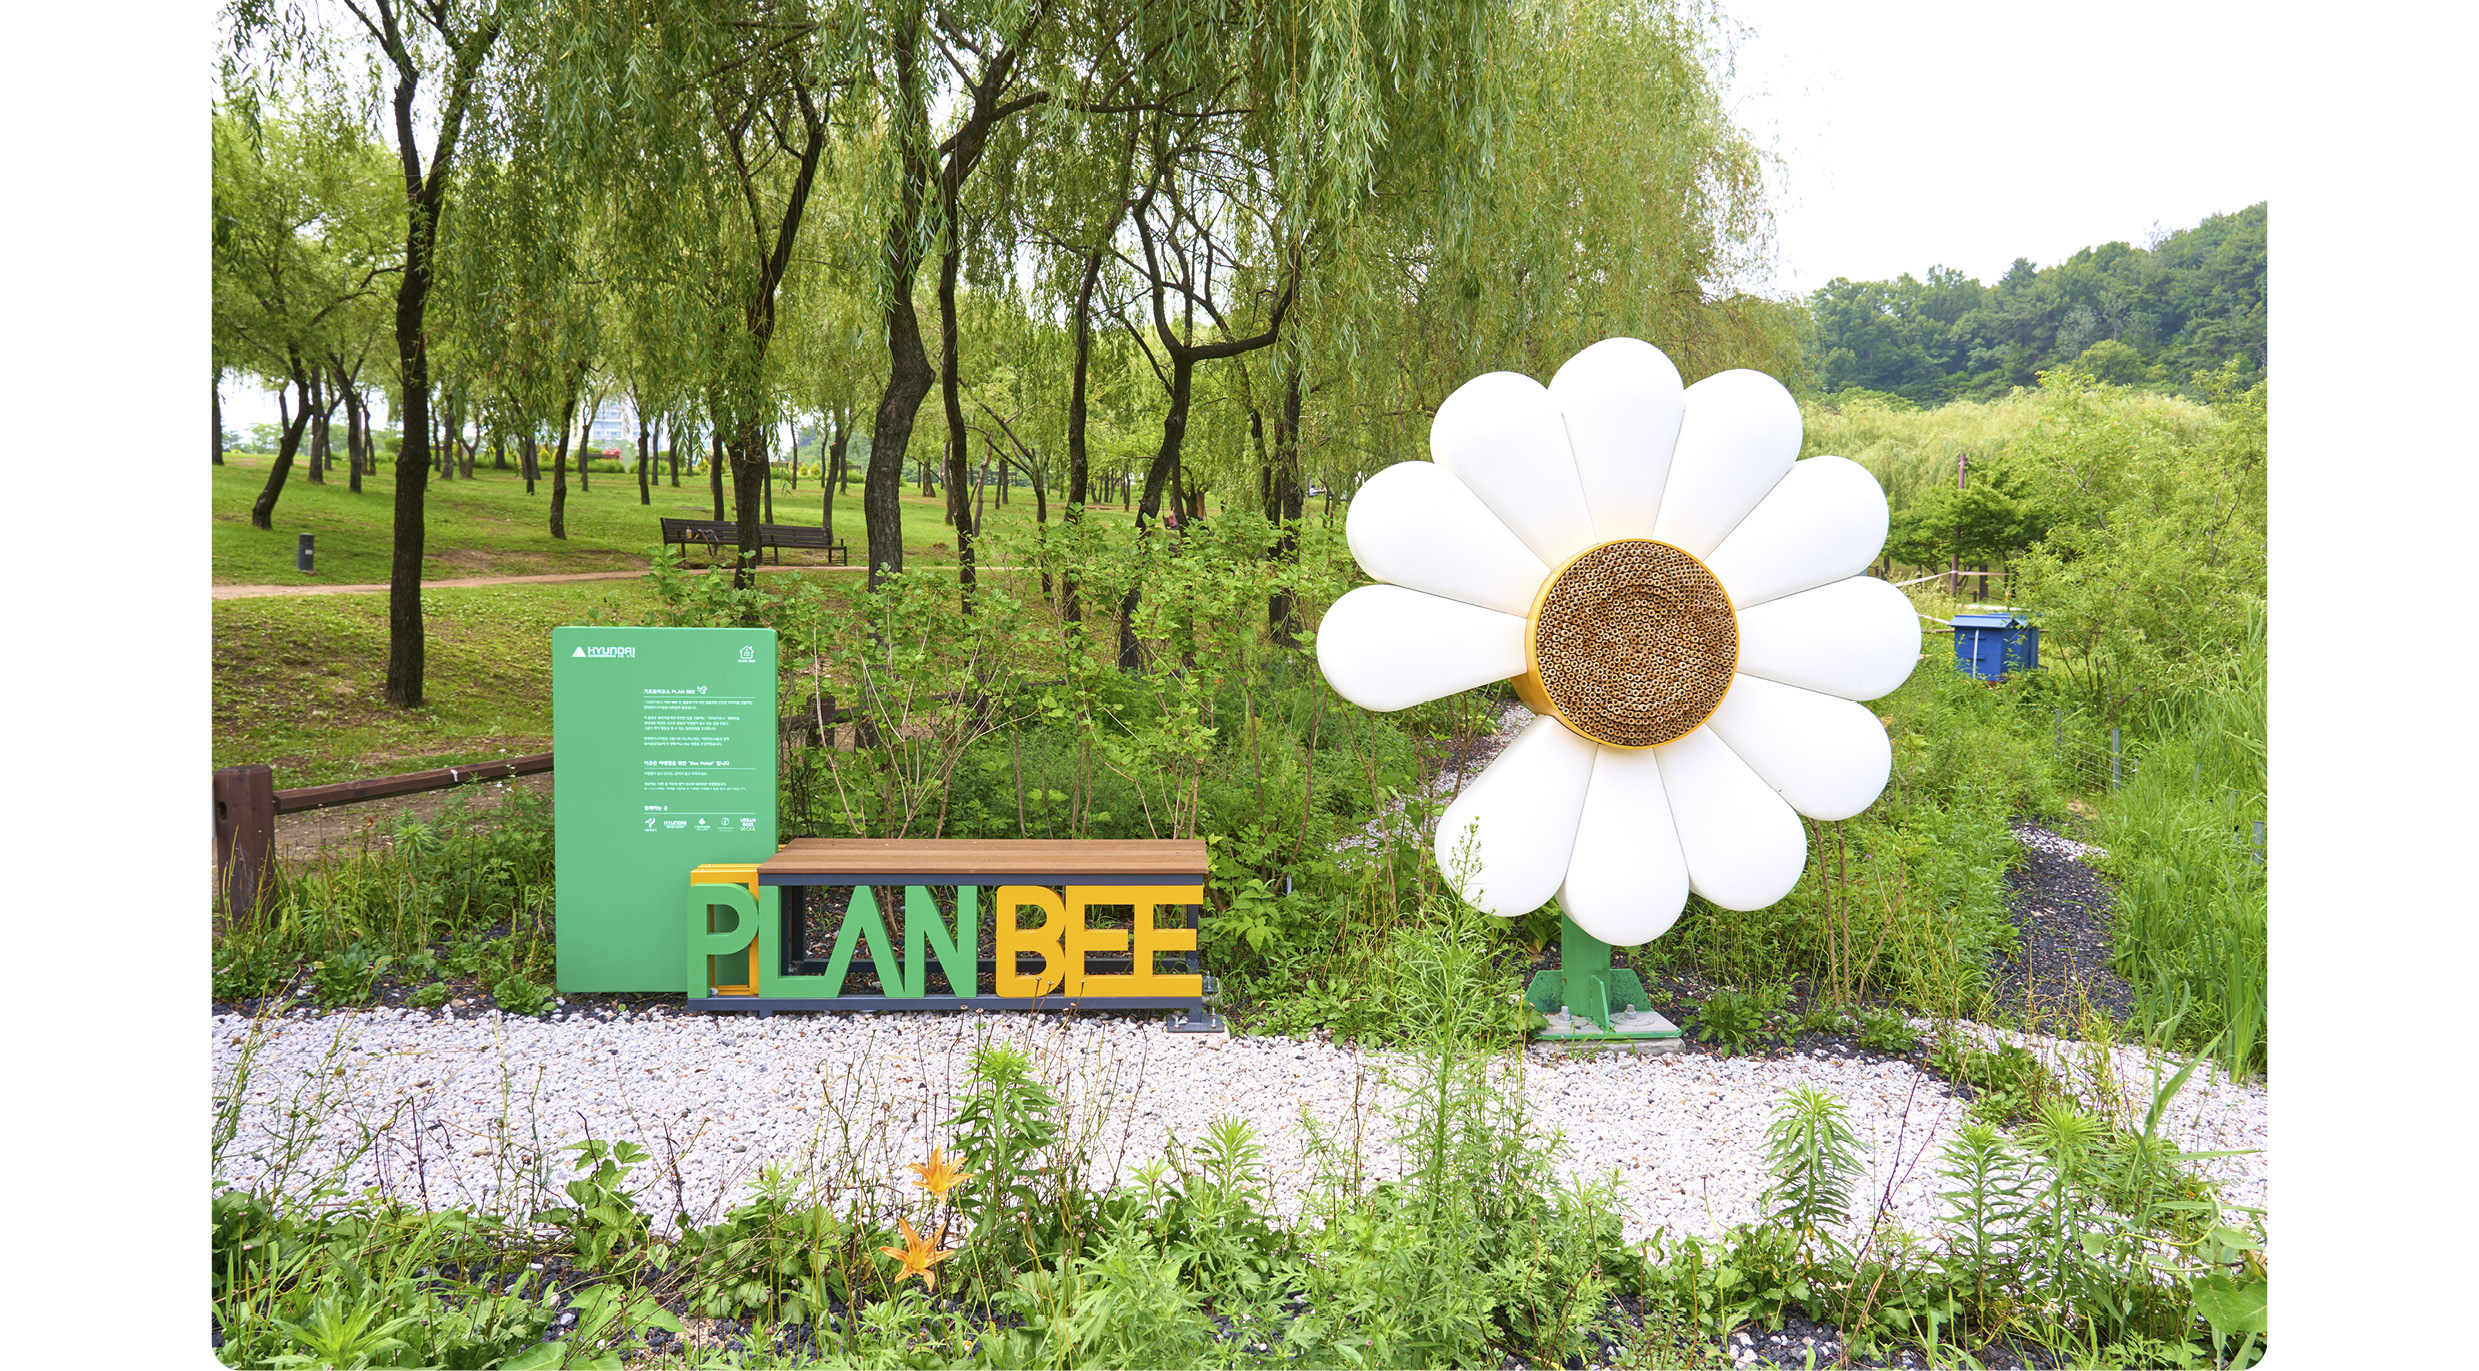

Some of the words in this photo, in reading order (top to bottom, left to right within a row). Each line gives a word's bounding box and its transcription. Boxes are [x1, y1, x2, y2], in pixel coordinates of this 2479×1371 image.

[587, 647, 636, 655] HYUNDAI
[687, 883, 978, 999] PLAN
[996, 885, 1204, 998] BEE
